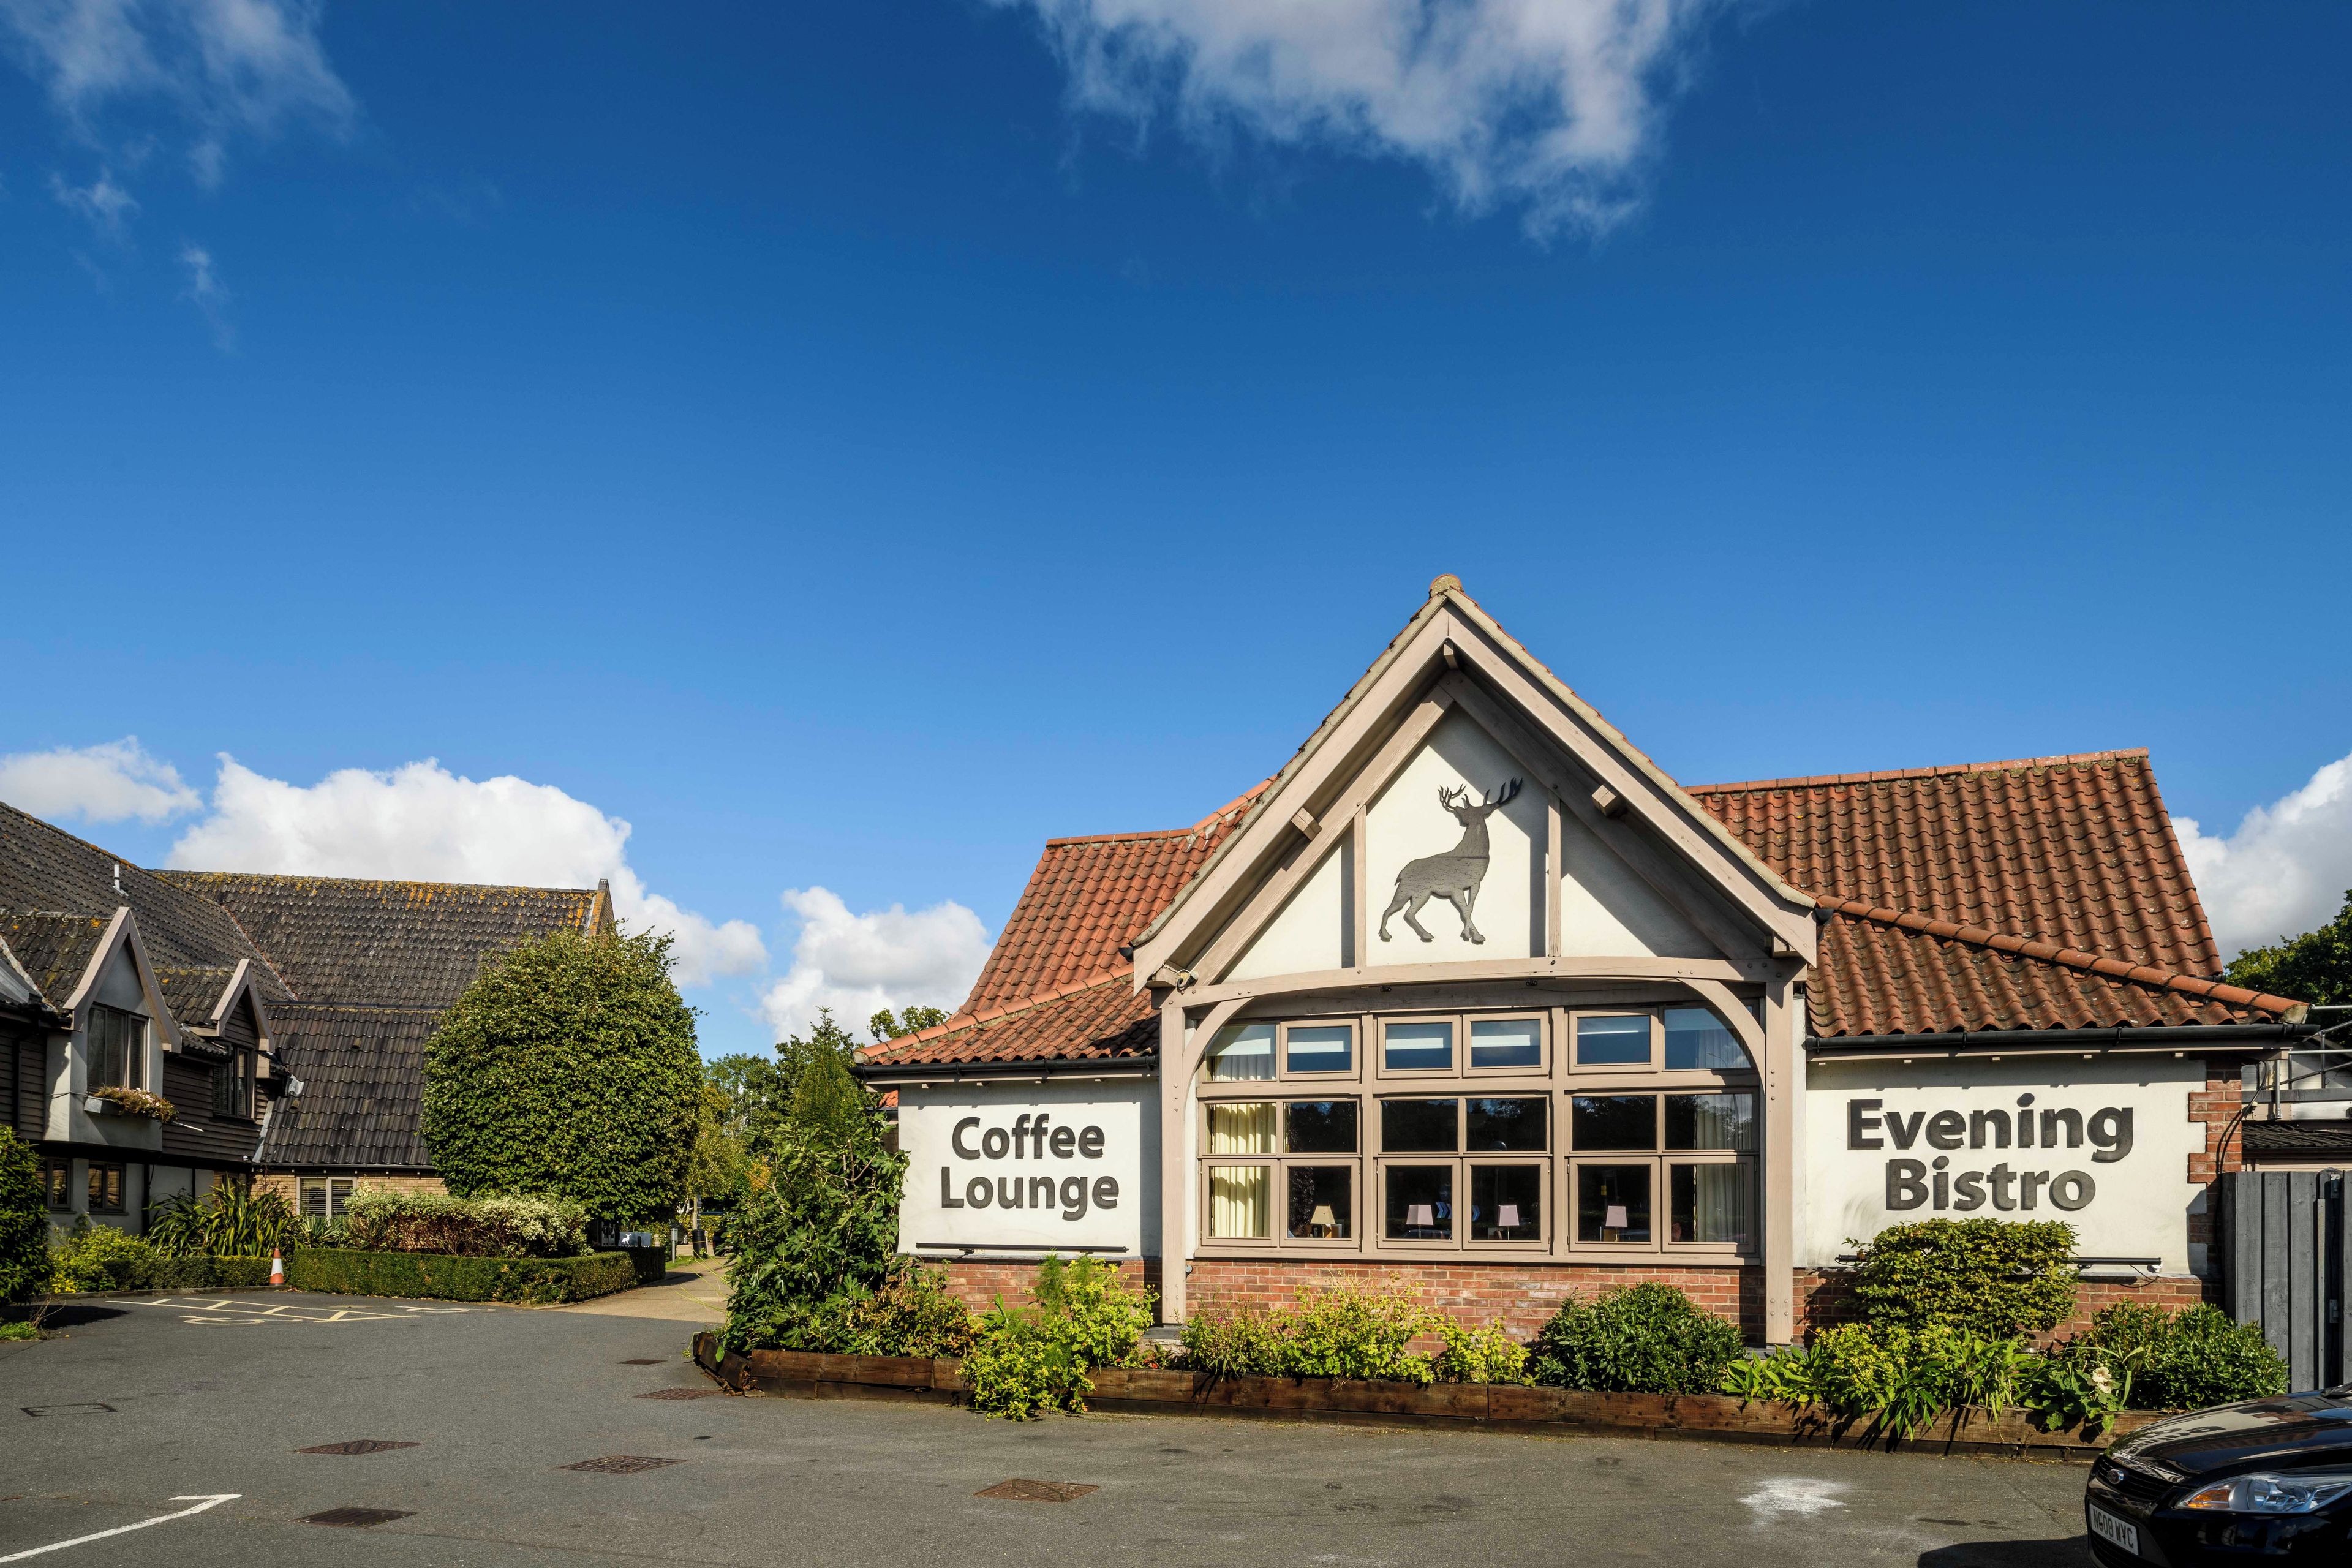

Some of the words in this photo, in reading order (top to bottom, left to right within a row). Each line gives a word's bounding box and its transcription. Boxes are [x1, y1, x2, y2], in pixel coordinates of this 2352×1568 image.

[952, 1113, 1105, 1159] Coffee
[1847, 1093, 2133, 1163] Evening
[941, 1166, 1119, 1221] Lounge
[1885, 1156, 2096, 1212] Bistro
[2115, 1521, 2134, 1548] WYC
